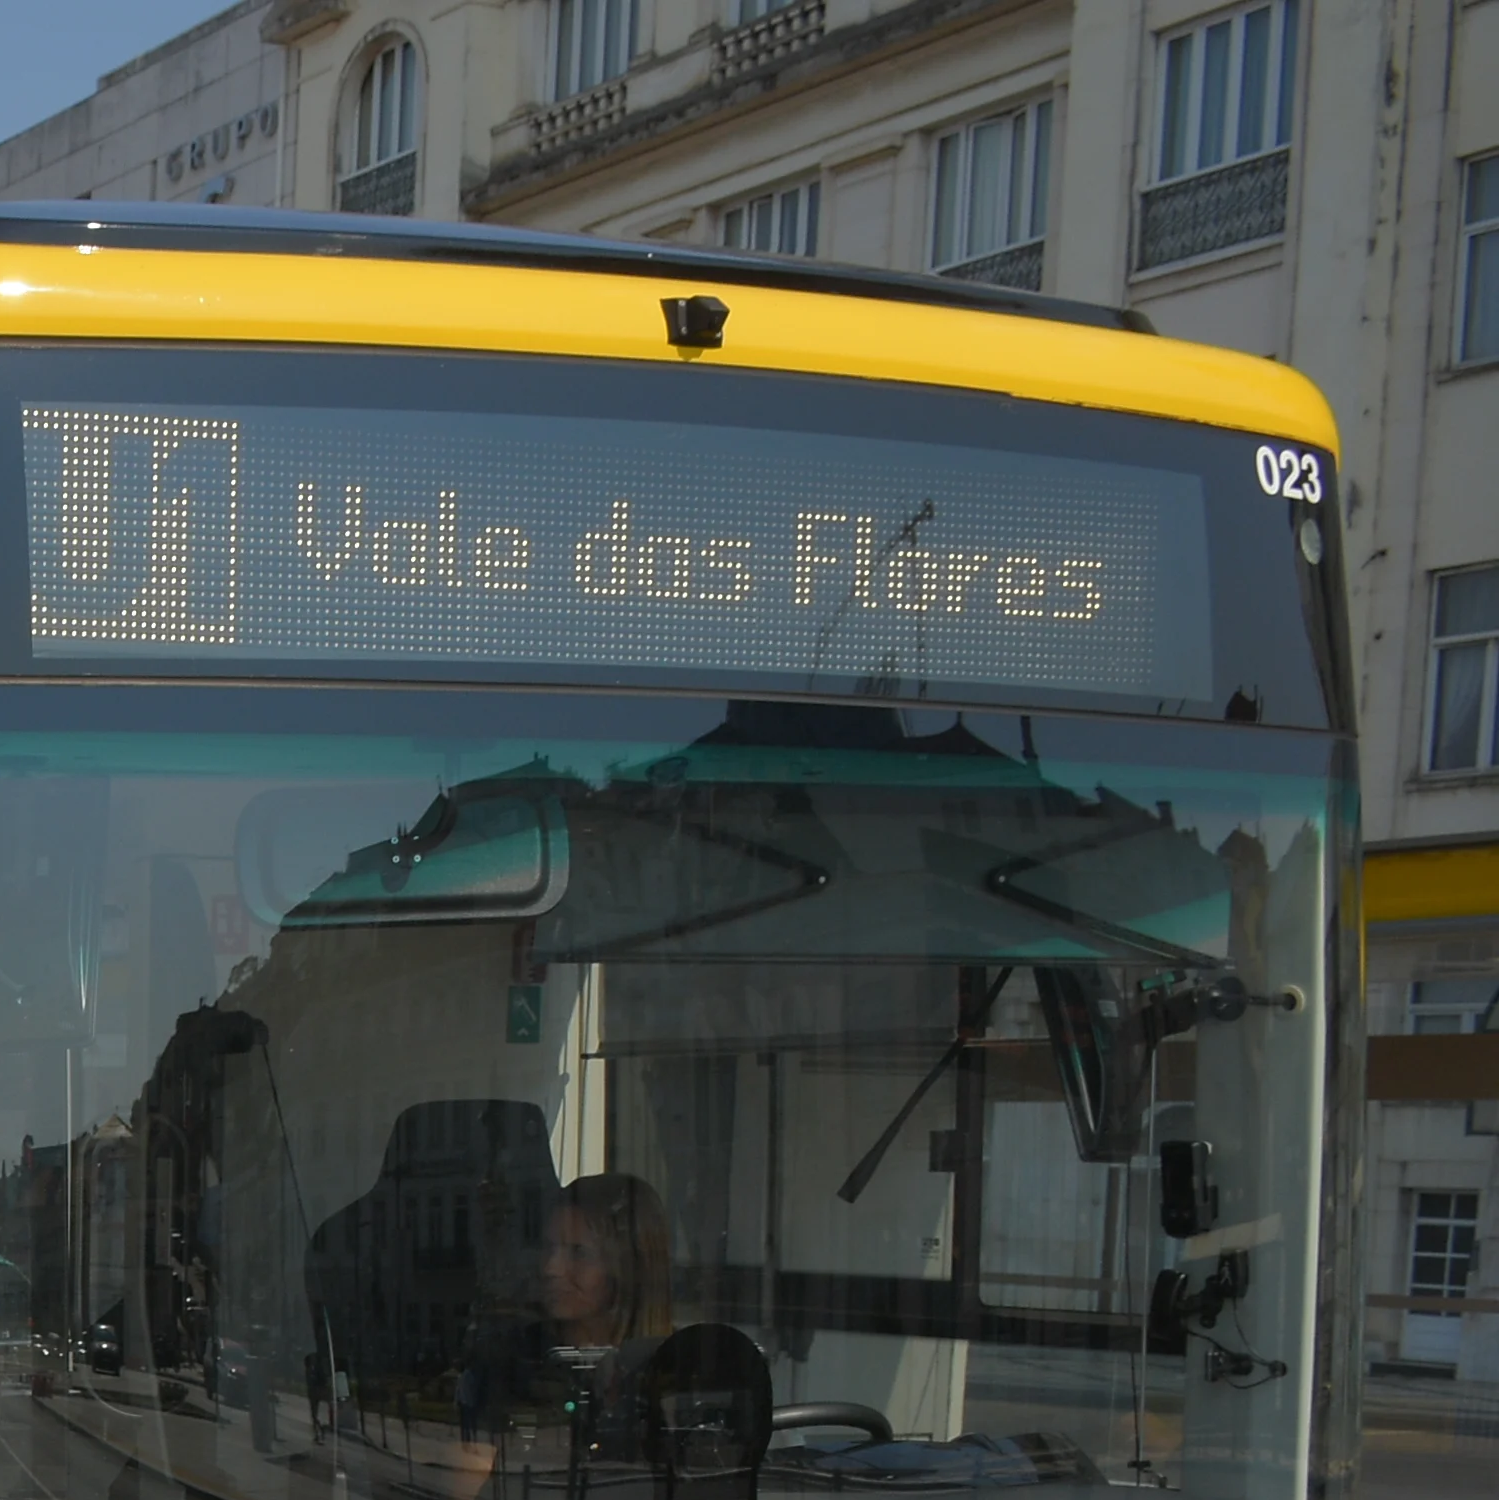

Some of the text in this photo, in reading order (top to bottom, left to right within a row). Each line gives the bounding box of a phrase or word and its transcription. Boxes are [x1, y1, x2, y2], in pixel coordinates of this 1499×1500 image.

[1255, 444, 1322, 504] 023
[297, 482, 531, 592] Vale
[573, 499, 753, 602] das
[795, 511, 1102, 621] Flores
